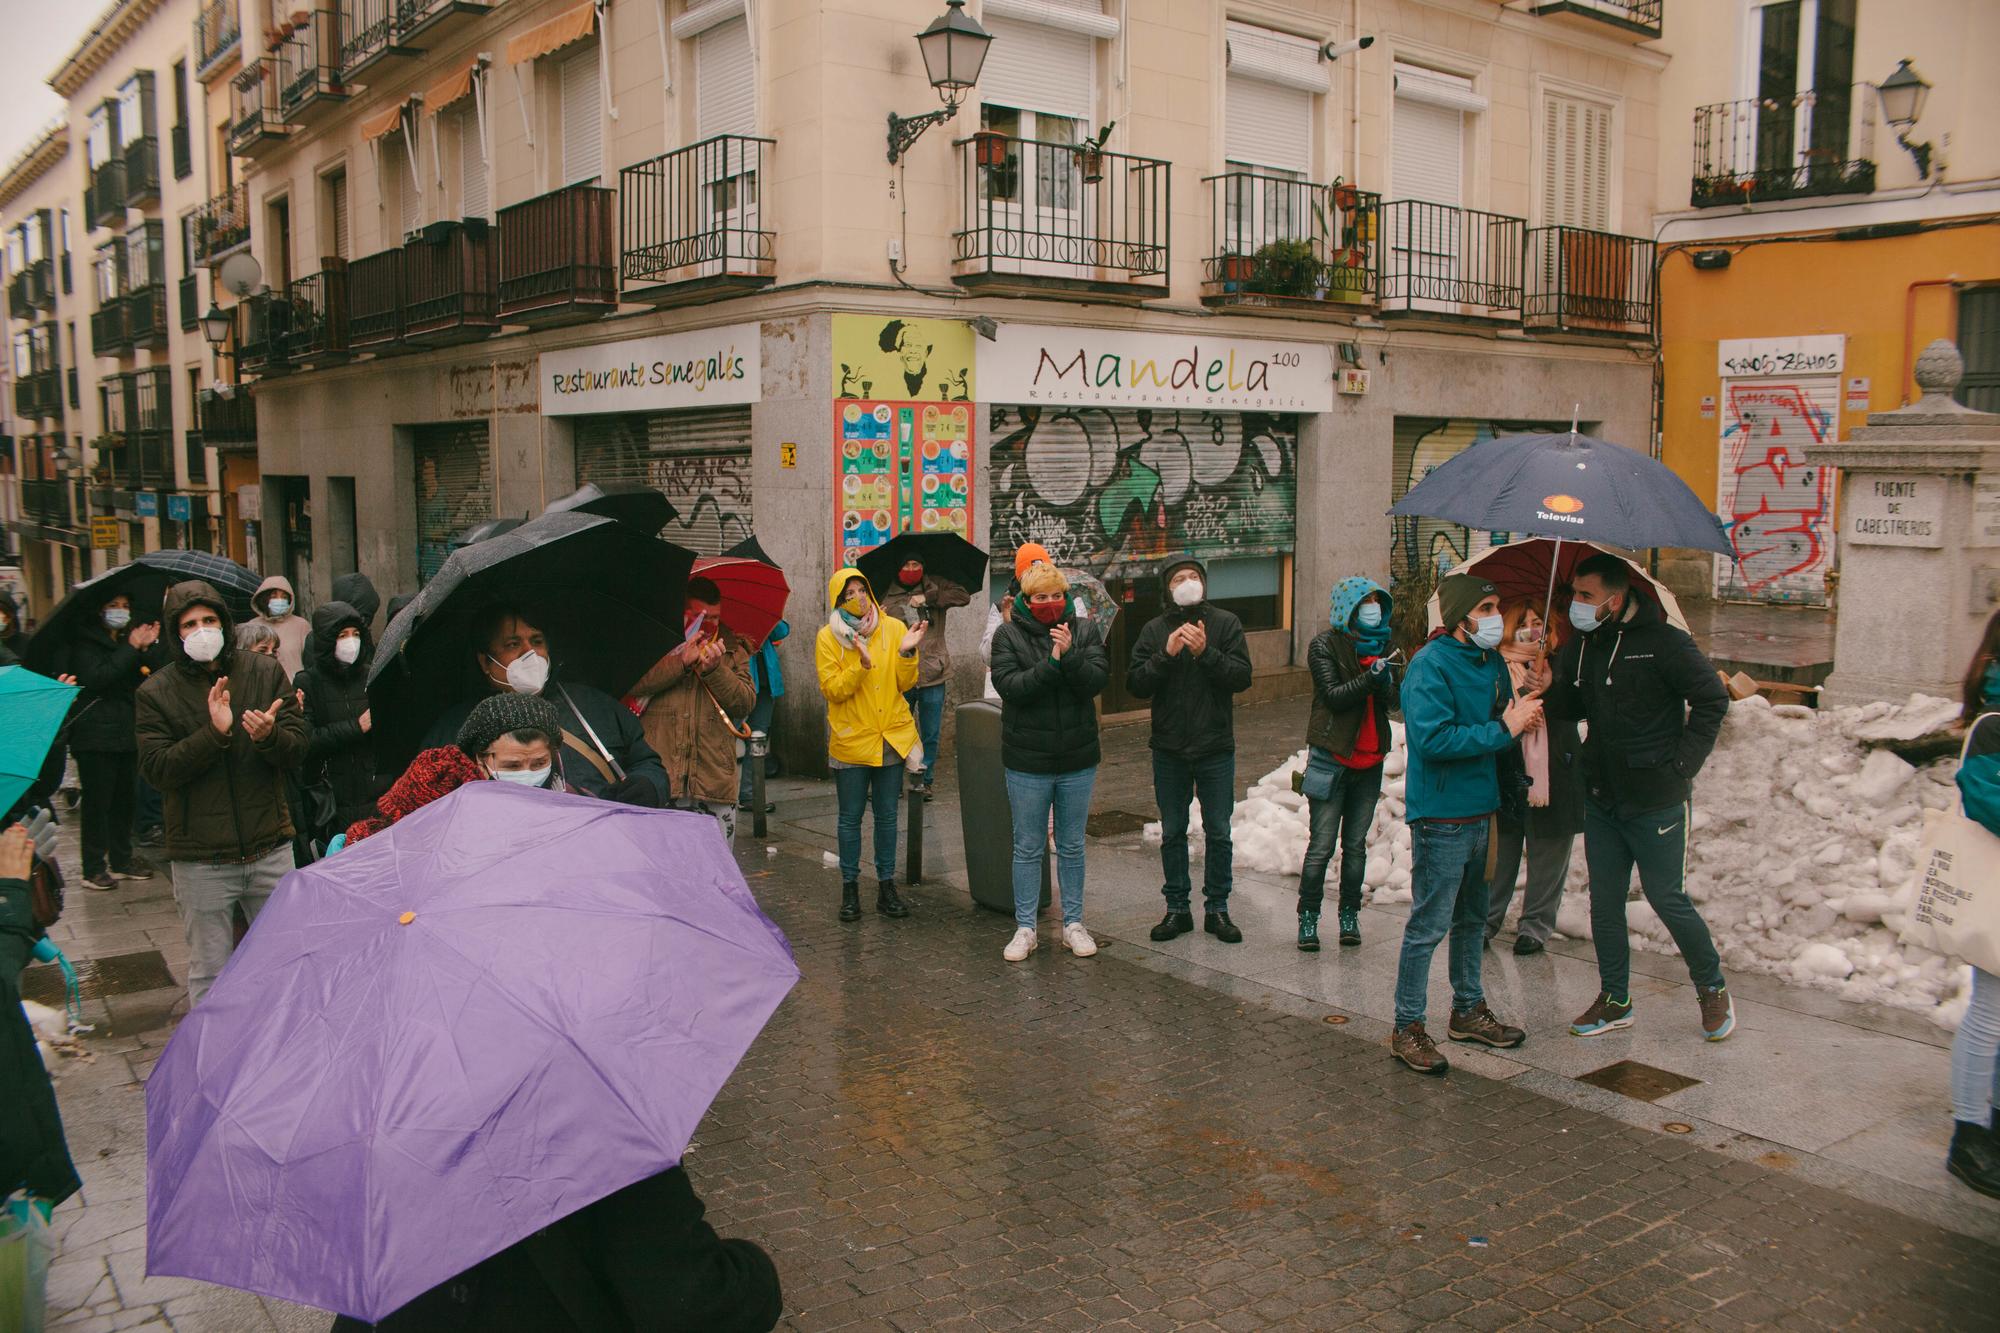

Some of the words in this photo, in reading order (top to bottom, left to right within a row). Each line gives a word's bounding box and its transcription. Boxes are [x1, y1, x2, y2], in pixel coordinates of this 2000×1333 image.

[553, 362, 645, 394] Restaurante
[650, 345, 745, 391] Senegalés
[1033, 346, 1268, 392] Mandela
[1272, 352, 1300, 368] 100
[1029, 390, 1192, 404] Restaurante
[1206, 394, 1304, 408] Senegalés
[1874, 481, 1917, 498] FUENTE
[1536, 511, 1585, 524] Televisa
[1888, 503, 1902, 515] DE
[1856, 518, 1933, 536] CABESTREROS
